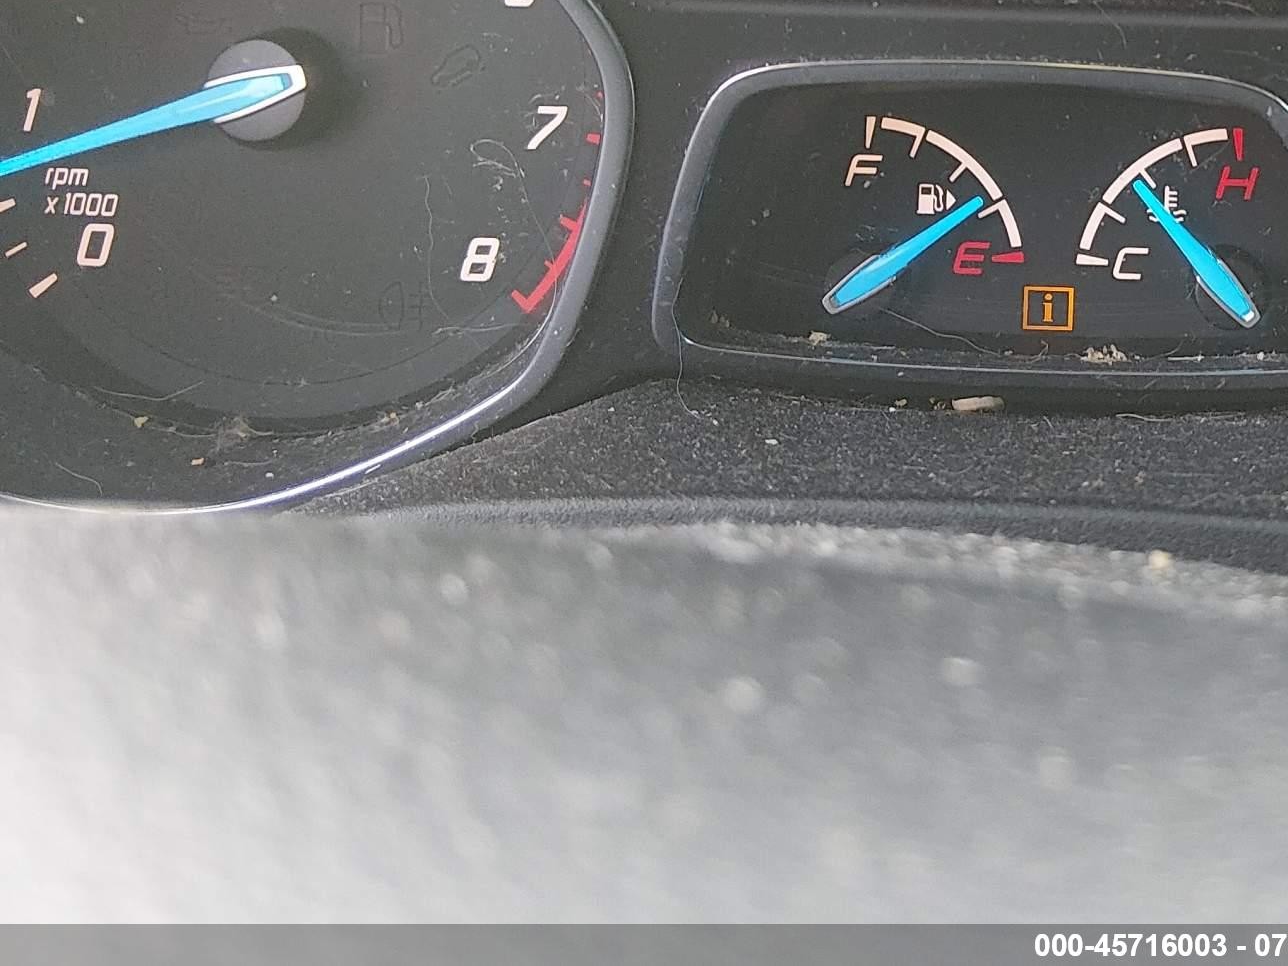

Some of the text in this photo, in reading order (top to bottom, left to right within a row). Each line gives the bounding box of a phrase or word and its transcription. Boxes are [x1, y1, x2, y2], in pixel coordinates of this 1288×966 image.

[23, 89, 41, 131] 1
[527, 106, 567, 150] 7
[45, 166, 88, 188] rpm
[844, 154, 883, 186] F
[1215, 166, 1259, 200] H
[77, 224, 114, 266] 0
[460, 238, 500, 281] 8
[953, 242, 991, 275] E
[1112, 248, 1149, 280] C
